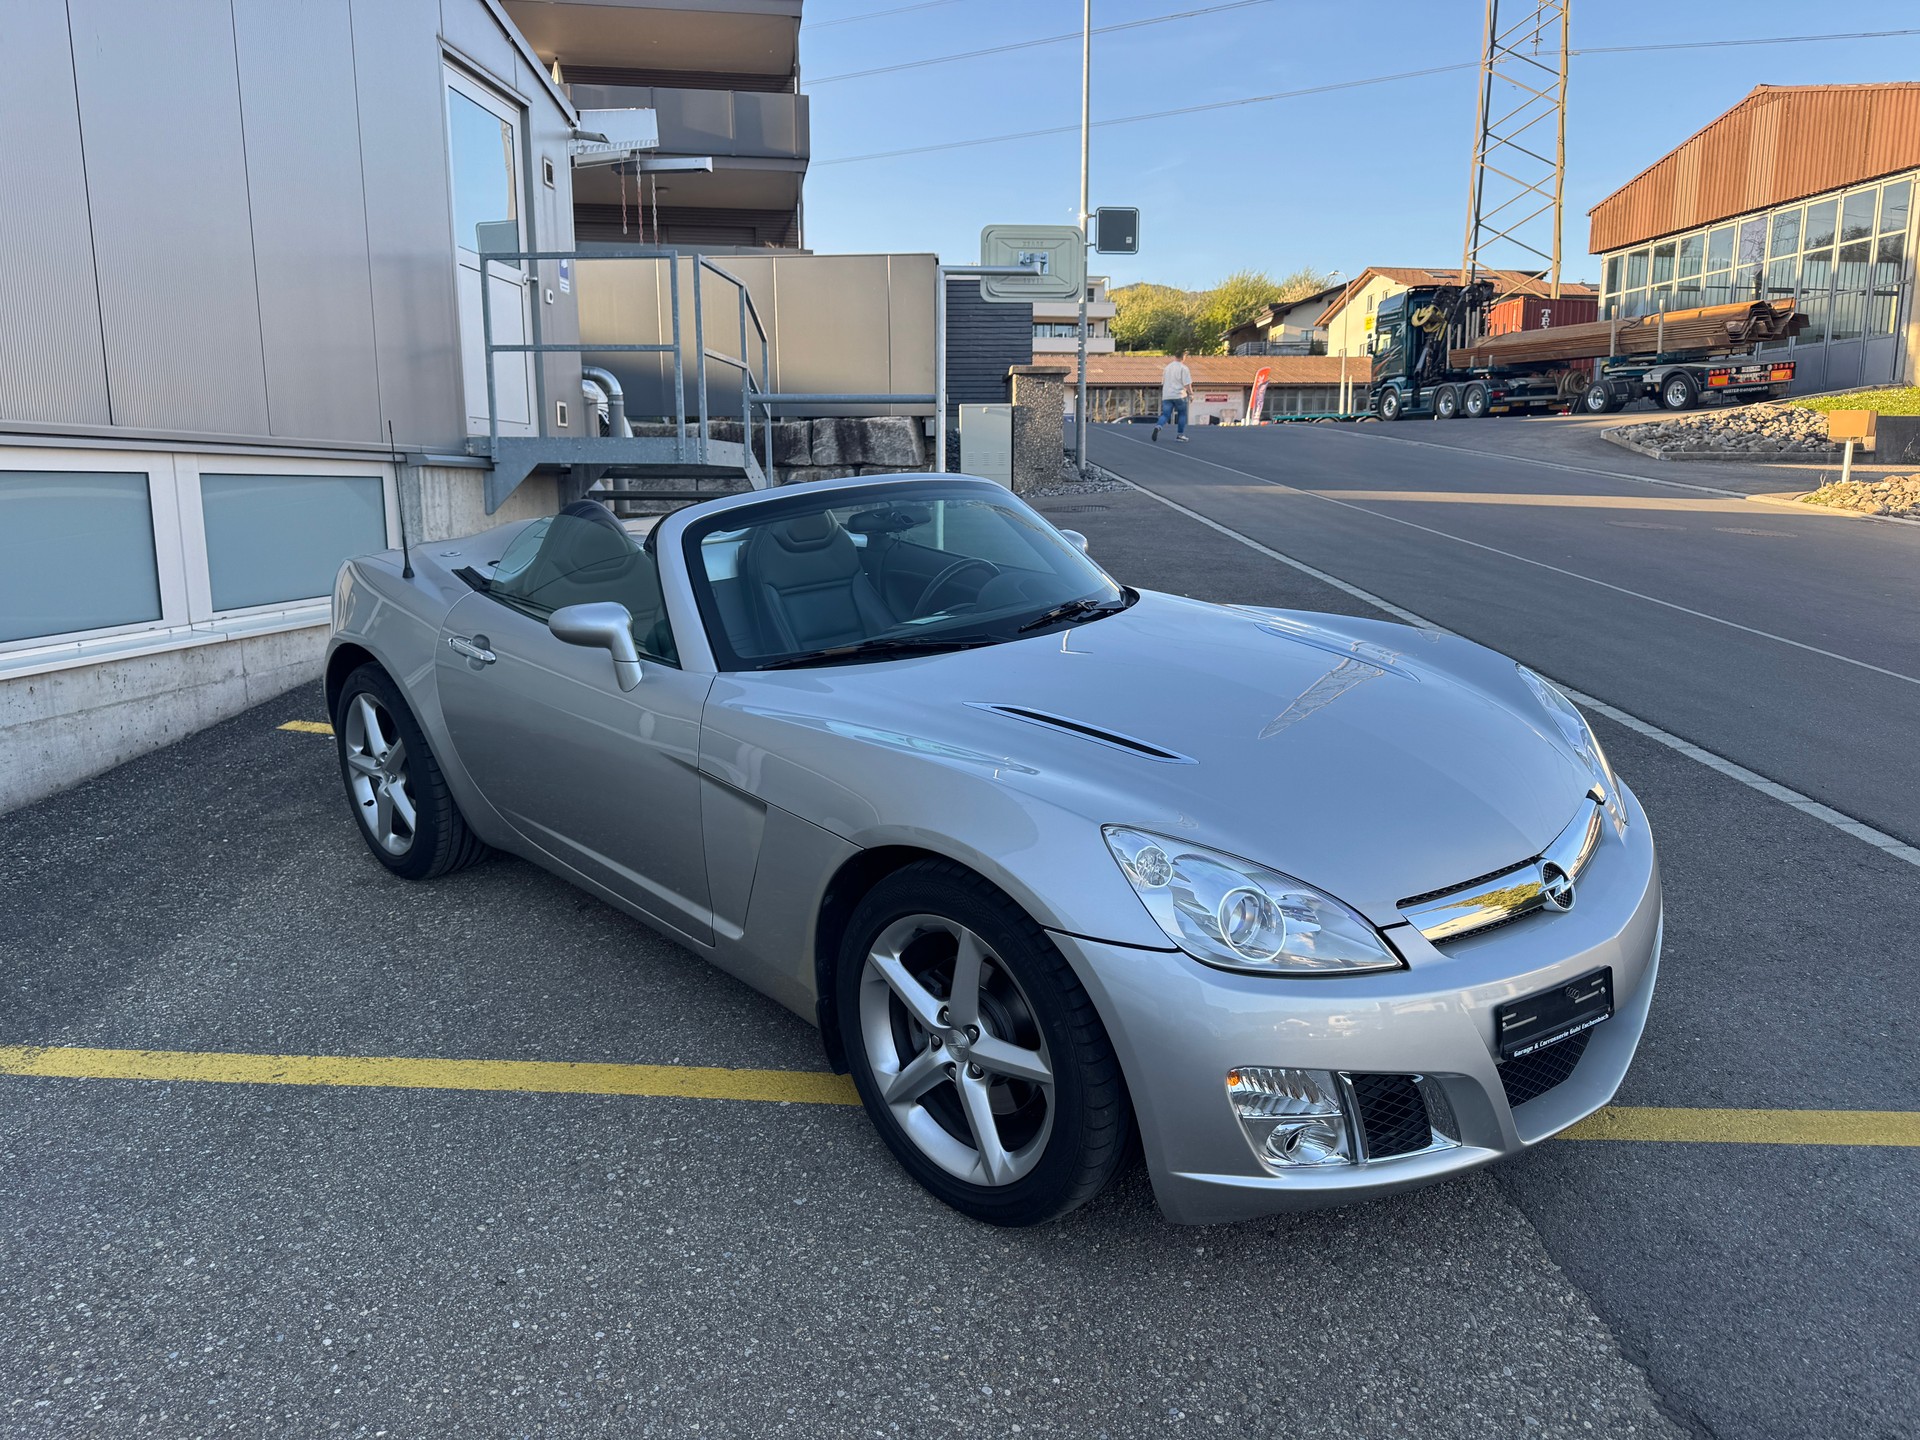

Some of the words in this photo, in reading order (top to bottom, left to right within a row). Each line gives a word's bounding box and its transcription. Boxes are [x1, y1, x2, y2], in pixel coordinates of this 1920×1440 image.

[1513, 1046, 1533, 1057] Garage
[1539, 1031, 1569, 1047] Carrosserie
[1581, 1013, 1609, 1029] Eschenbach
